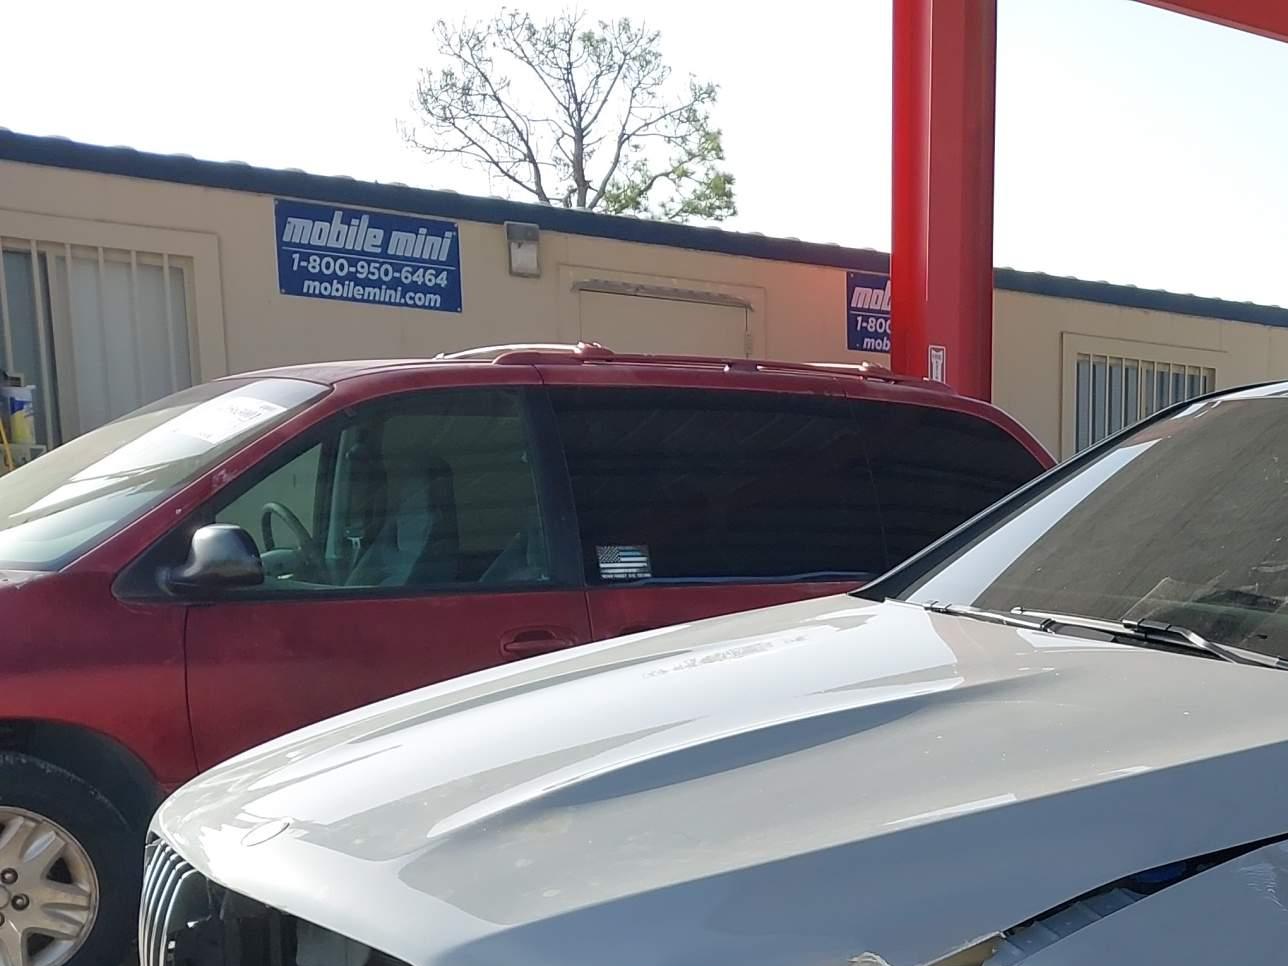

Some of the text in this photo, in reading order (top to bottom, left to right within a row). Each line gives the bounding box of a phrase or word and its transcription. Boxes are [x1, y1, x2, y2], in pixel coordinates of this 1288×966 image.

[282, 210, 452, 262] mobile mini
[291, 253, 448, 288] 1-800-950-6464
[303, 279, 441, 307] mobilemini.com
[851, 280, 891, 311] mob
